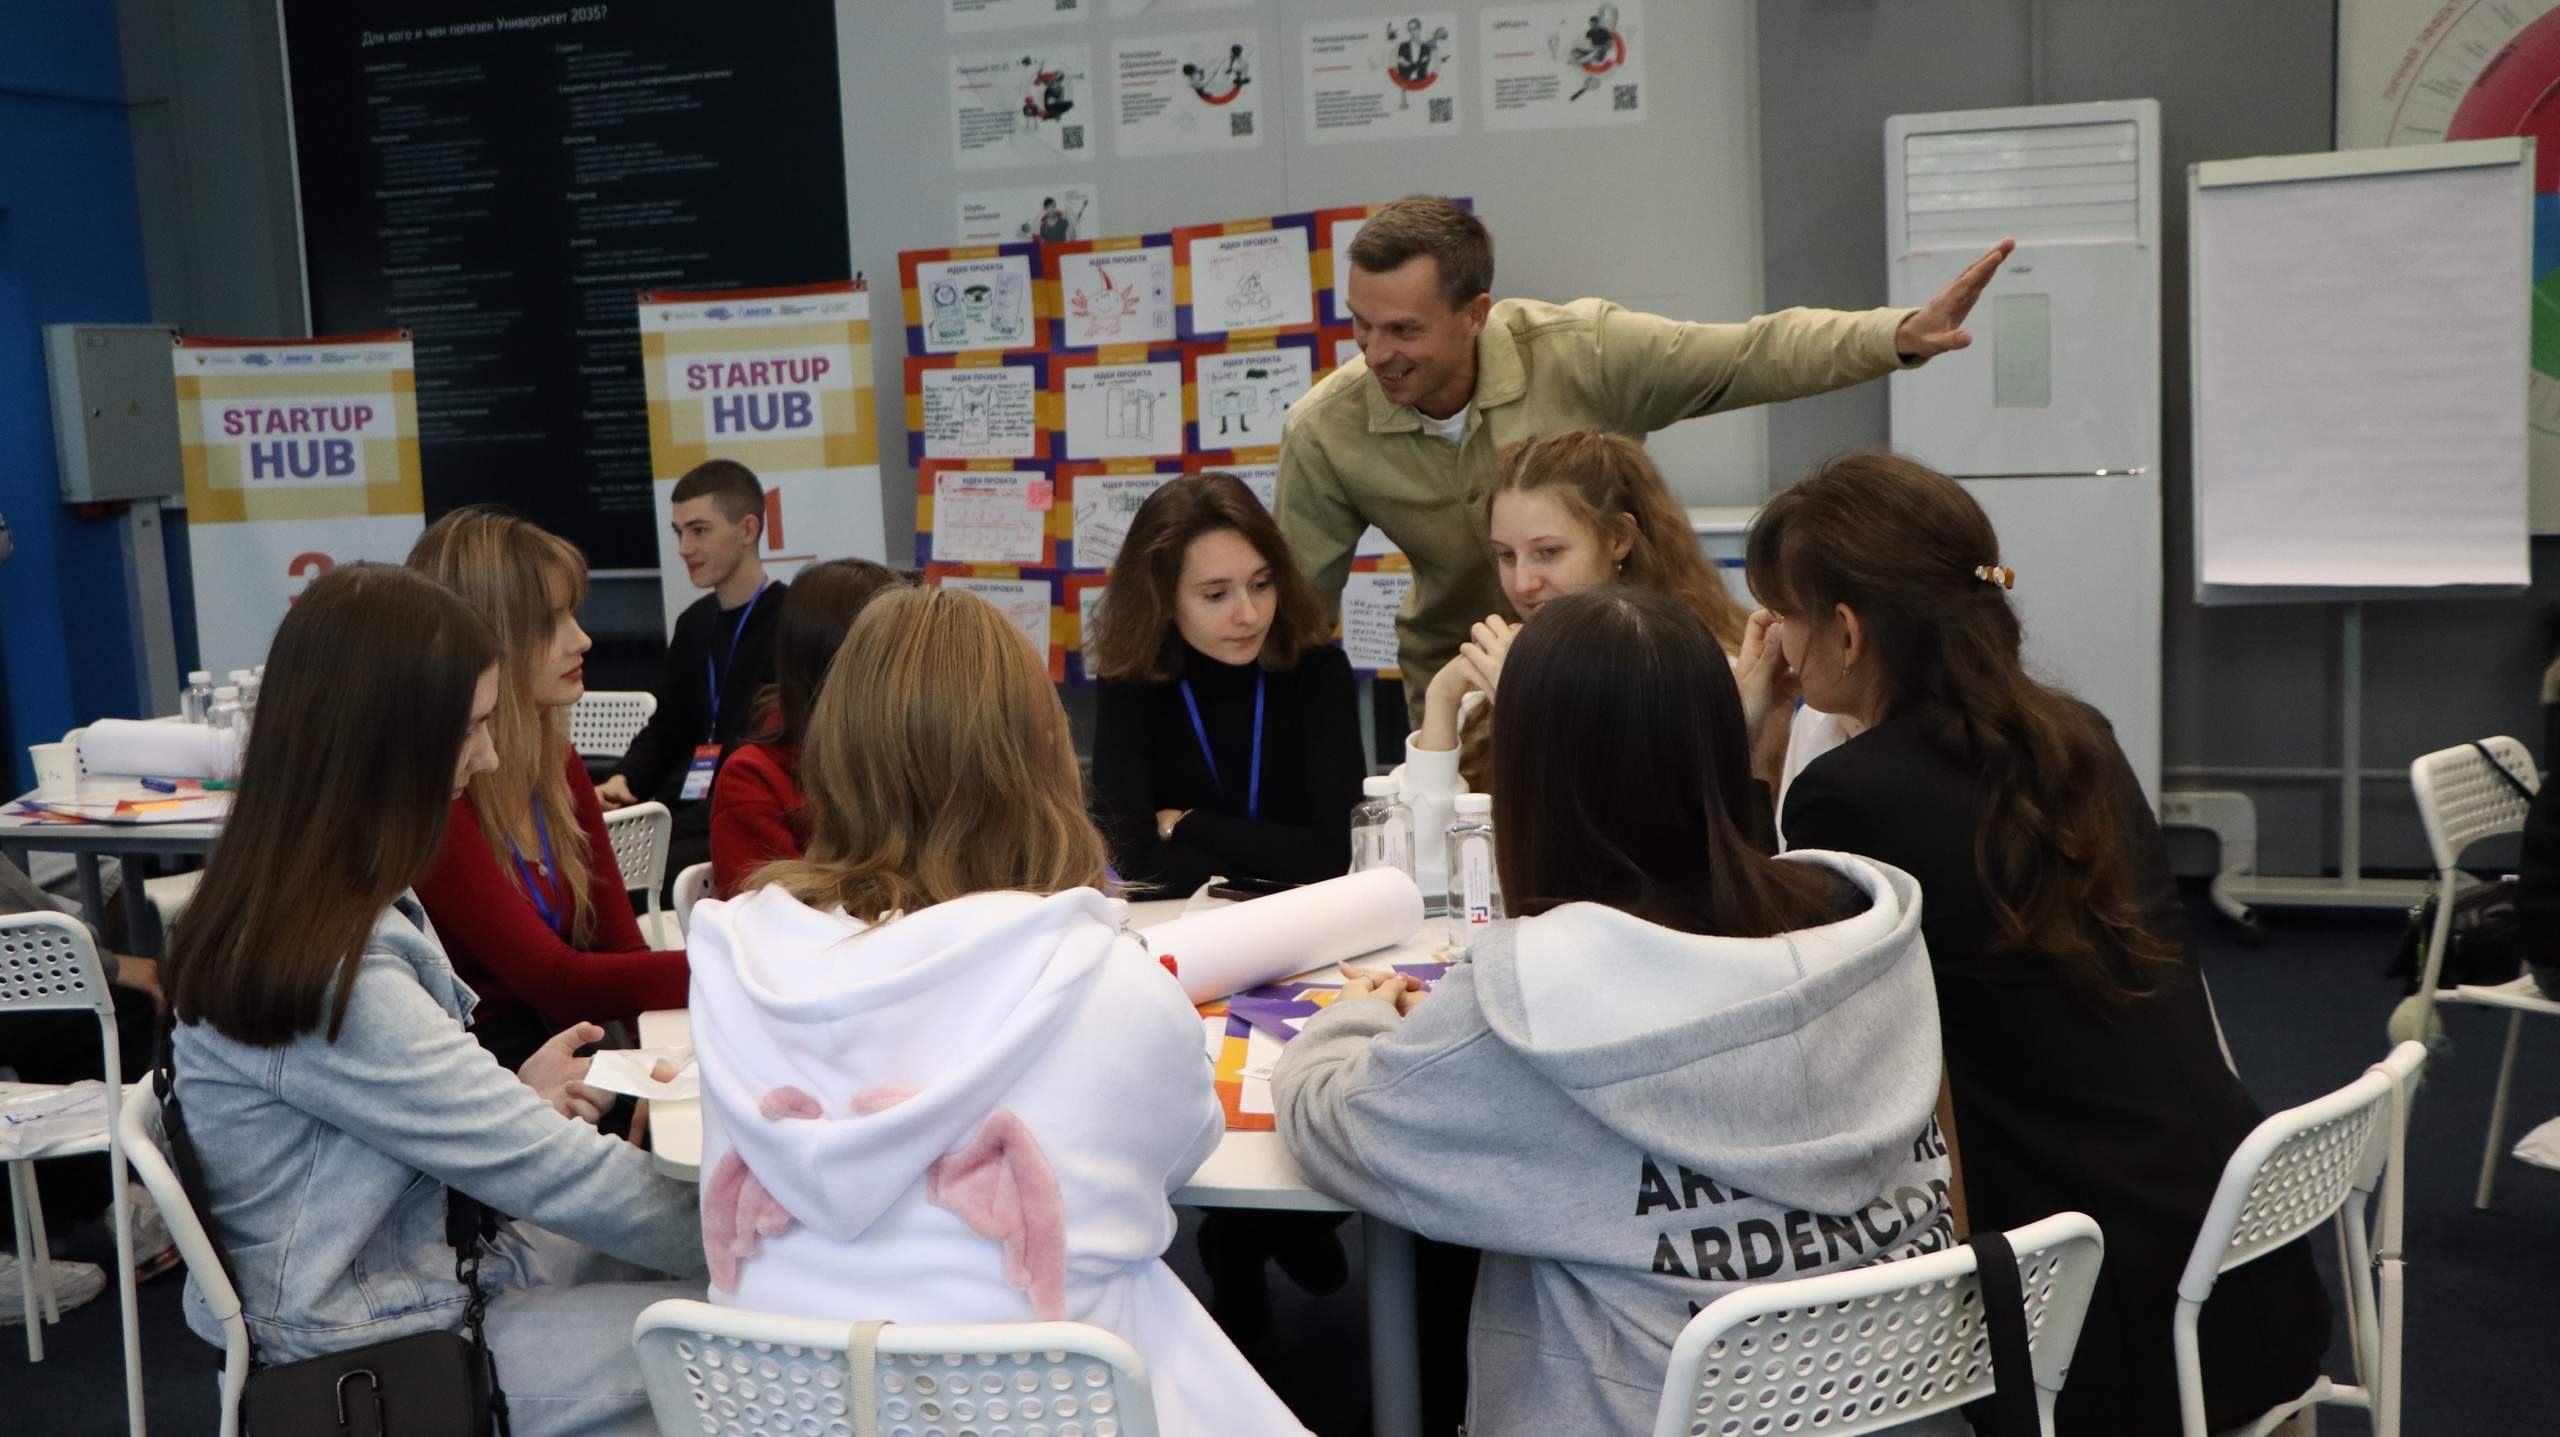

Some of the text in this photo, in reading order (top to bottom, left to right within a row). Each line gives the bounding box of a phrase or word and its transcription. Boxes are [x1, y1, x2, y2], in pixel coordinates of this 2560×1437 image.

[361, 4, 608, 47] Для кого и чем полезен Университет 2035?
[1220, 237, 1279, 251] ИДЕЯ ПРОЕКТА
[1089, 254, 1148, 267] ИДЕЯ ПРОЕКТА
[947, 262, 1004, 275] ИДЕЯ ПРОЕКТА
[1223, 355, 1282, 367] ИДЕЯ ПРОЕКТА
[687, 356, 830, 391] STARTUP
[951, 372, 1008, 382] ИДЕЯ ПРОЕКТА
[1094, 369, 1152, 380] ИДЕЯ ПРОЕКТА
[712, 391, 813, 433] HUB
[223, 405, 374, 436] STARTUP
[250, 438, 356, 480] HUB
[1255, 468, 1277, 478] ПРОЕ
[963, 477, 1018, 486] ИДЕЯ ПРОЕКТА
[1102, 479, 1160, 489] ИДЕЯ ПРОЕКТА
[764, 486, 784, 551] 1
[989, 585, 1024, 593] ПРОЕКТА
[1373, 578, 1396, 587] ИДЕЯ
